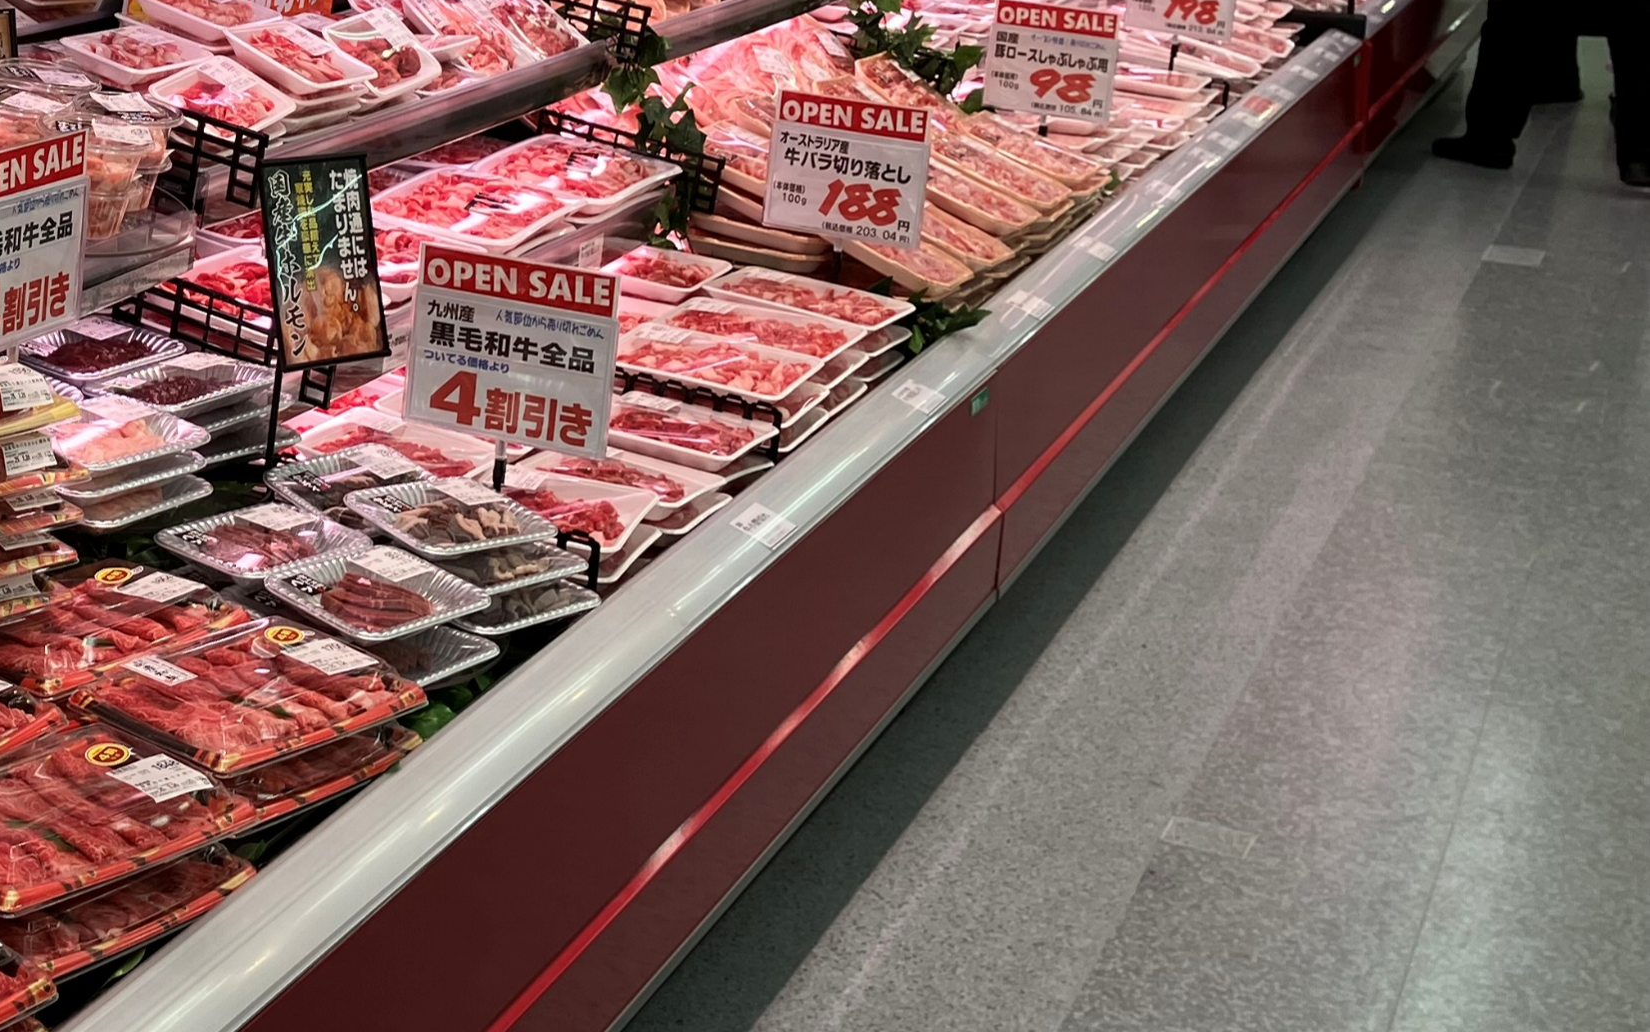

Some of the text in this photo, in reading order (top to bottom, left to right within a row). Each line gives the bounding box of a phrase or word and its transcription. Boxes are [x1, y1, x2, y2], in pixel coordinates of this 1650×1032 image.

[999, 6, 1115, 32] OPEN SALE
[996, 31, 1019, 44] 国産
[994, 44, 1109, 73] 豚ロースしゃぶしゃぶ用
[999, 80, 1019, 90] 100g
[1029, 68, 1103, 109] 98 円
[782, 99, 925, 134] OPEN SALE
[33, 134, 84, 181] SALE
[780, 131, 850, 155] オーストラリア産
[784, 147, 912, 184] 牛バラ切り落とし
[782, 192, 807, 206] 100g
[818, 178, 911, 233] 188 円
[329, 169, 359, 312] たまりません。
[342, 168, 369, 279] 焼肉通には
[427, 257, 611, 307] OPEN SALE
[427, 300, 476, 323] 九州産
[495, 309, 605, 339] 人気部位から売り切れごめん
[423, 349, 510, 374] ついてる価格より
[429, 321, 595, 374] 黒毛和牛全品
[429, 370, 593, 448] 4割引き
